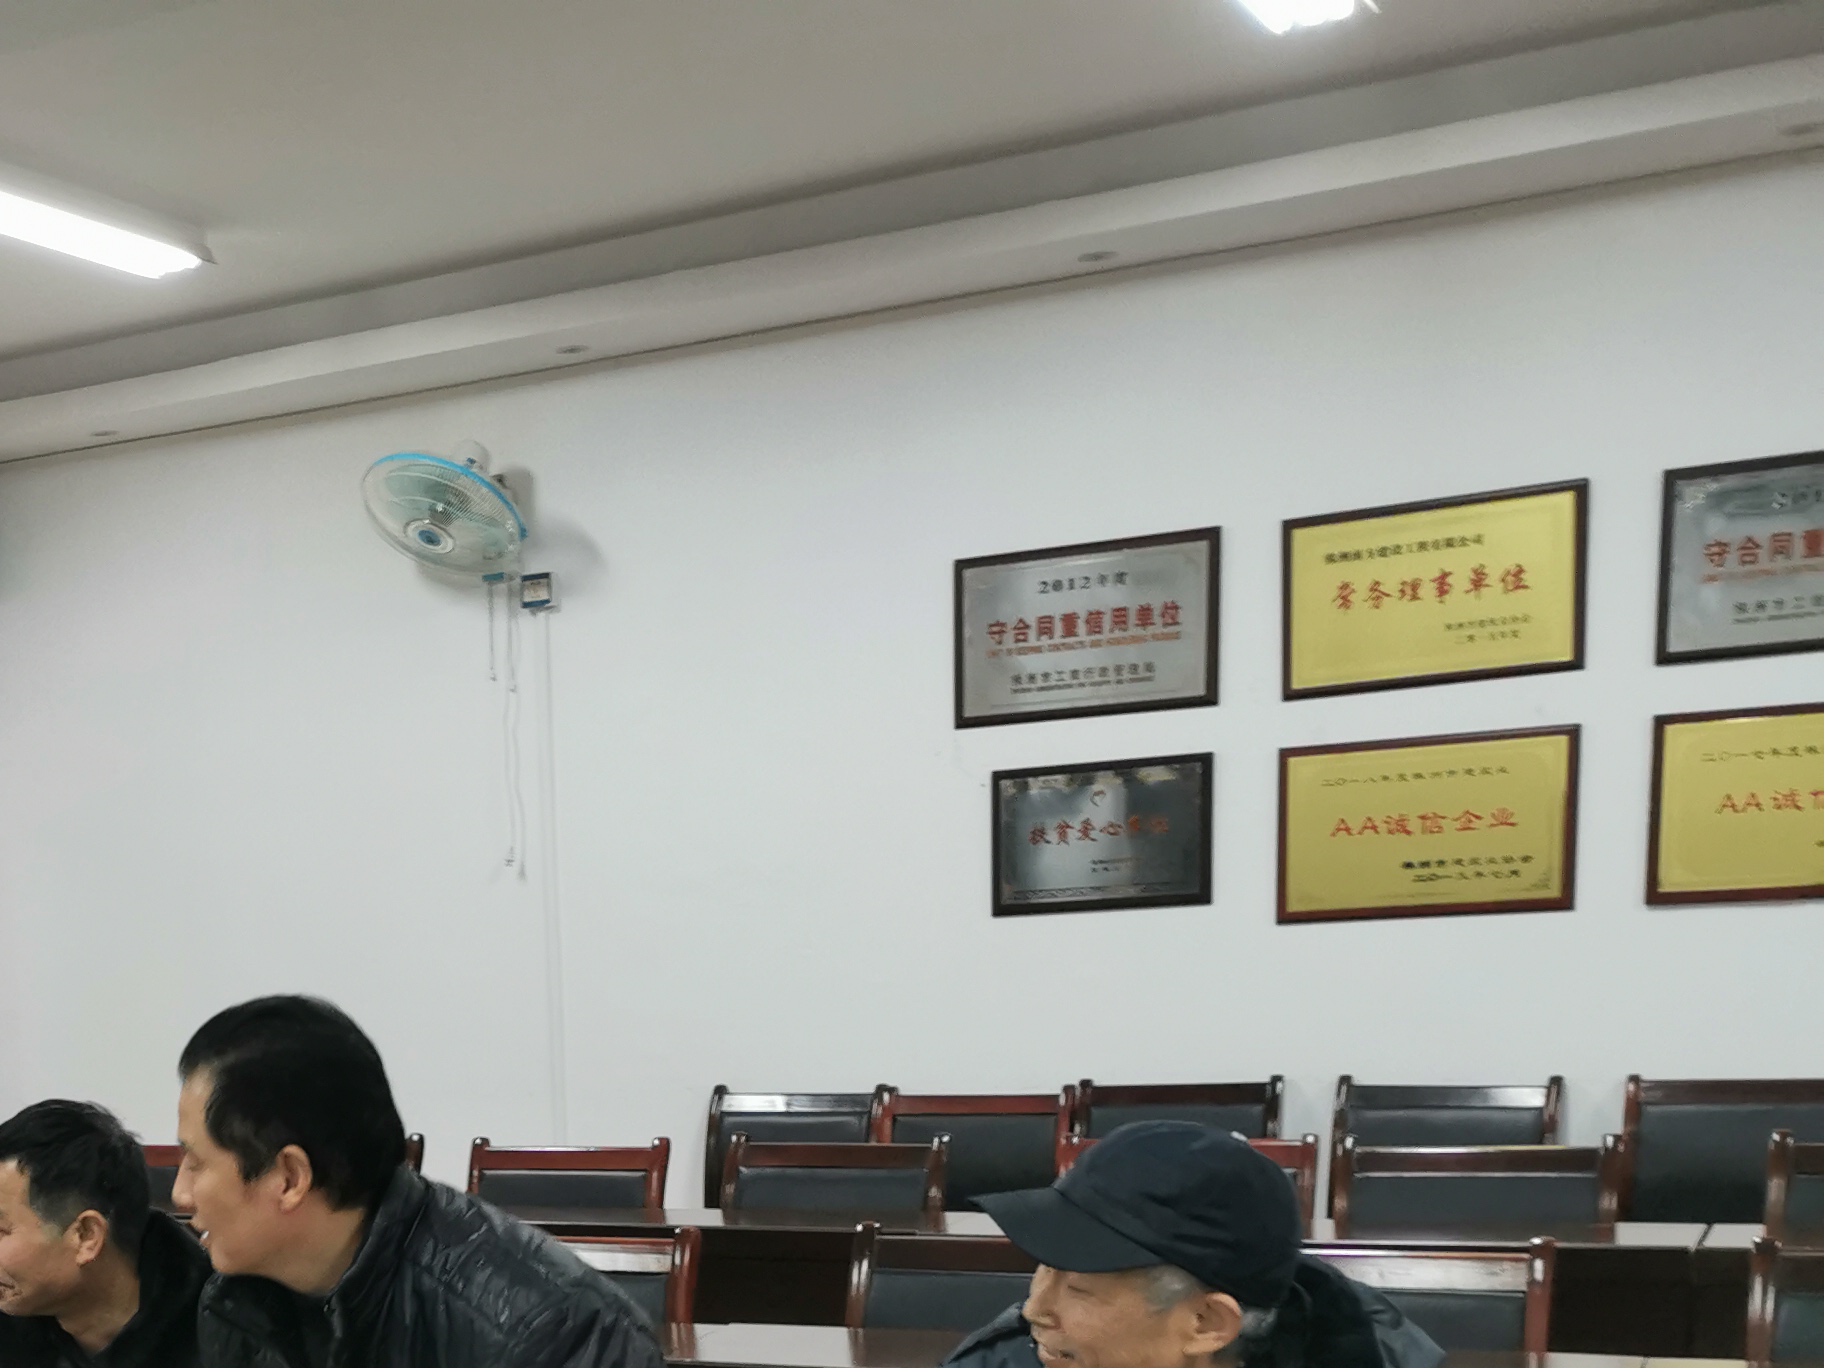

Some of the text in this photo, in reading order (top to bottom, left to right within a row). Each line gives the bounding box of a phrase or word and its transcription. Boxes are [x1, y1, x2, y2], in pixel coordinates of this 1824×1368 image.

[1332, 563, 1531, 611] 常务理事单位
[986, 600, 1182, 646] 守合同重信用单位
[1330, 807, 1518, 837] AA诚信企业
